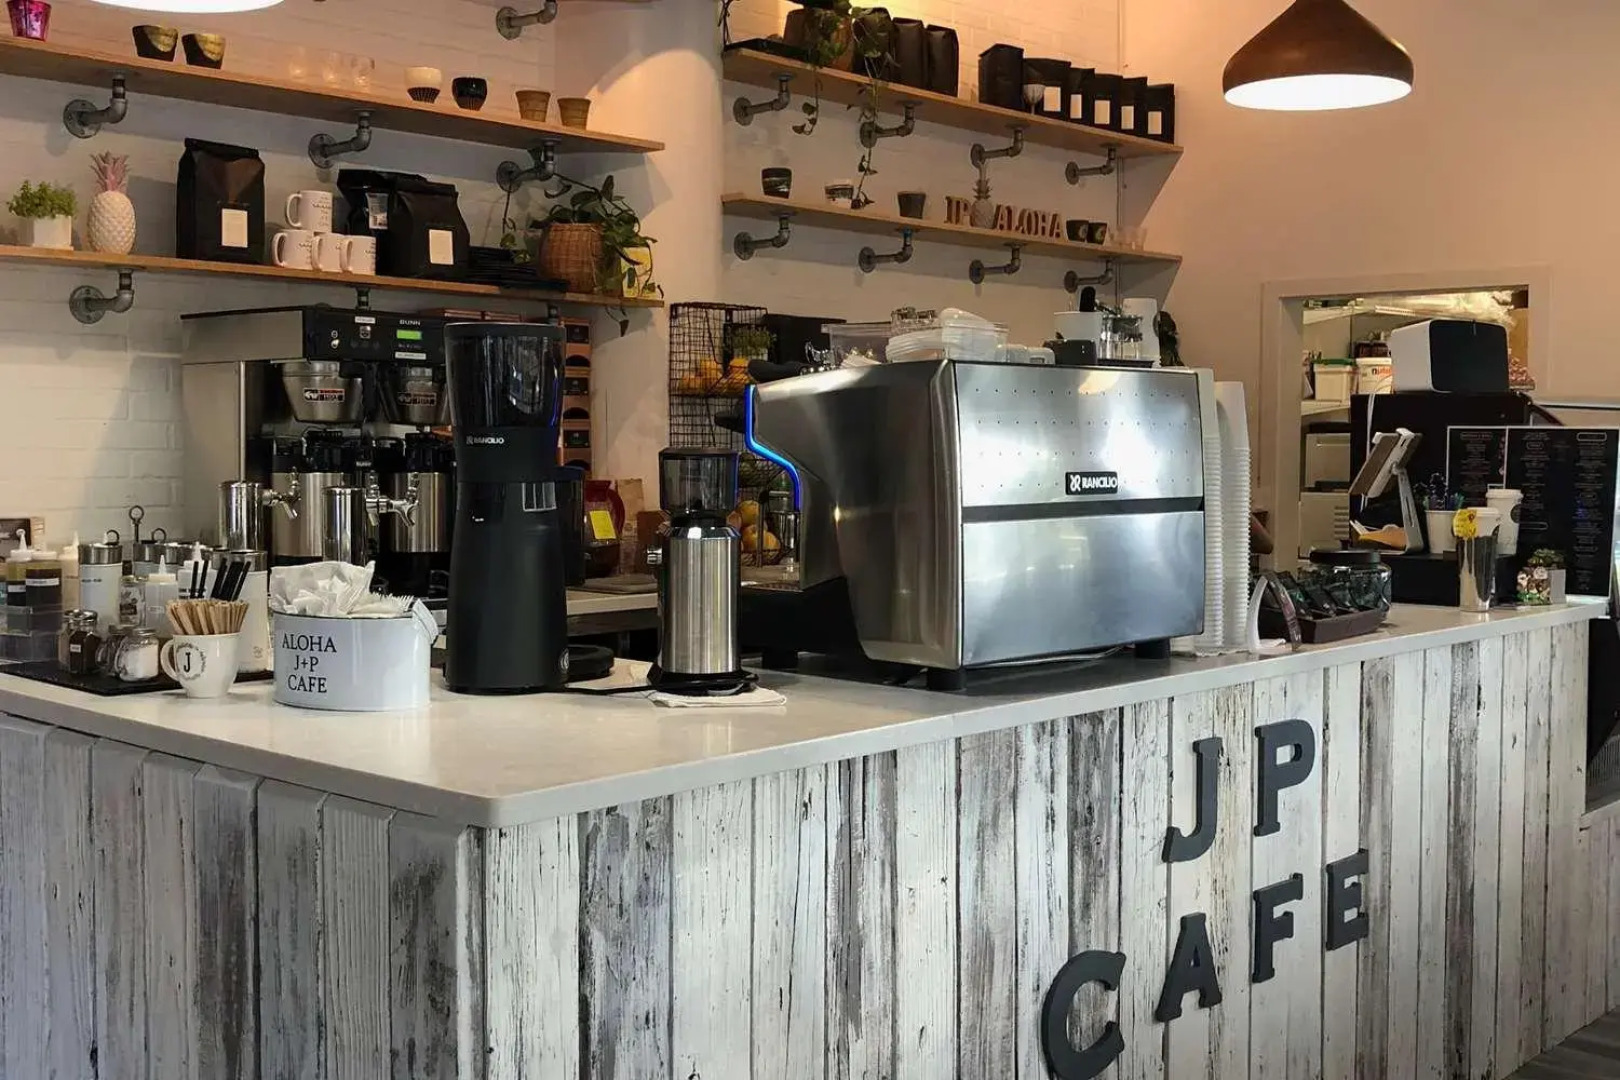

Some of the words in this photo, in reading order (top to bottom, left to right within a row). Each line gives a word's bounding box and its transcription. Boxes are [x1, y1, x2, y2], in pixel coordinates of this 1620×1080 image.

[993, 204, 1062, 239] ALOHA
[1081, 476, 1119, 489] RANCILIO
[282, 632, 337, 653] ALOHA
[183, 652, 191, 673] J
[293, 655, 319, 672] J+P
[287, 674, 327, 693] CAFE
[1041, 848, 1369, 1080] CAFE
